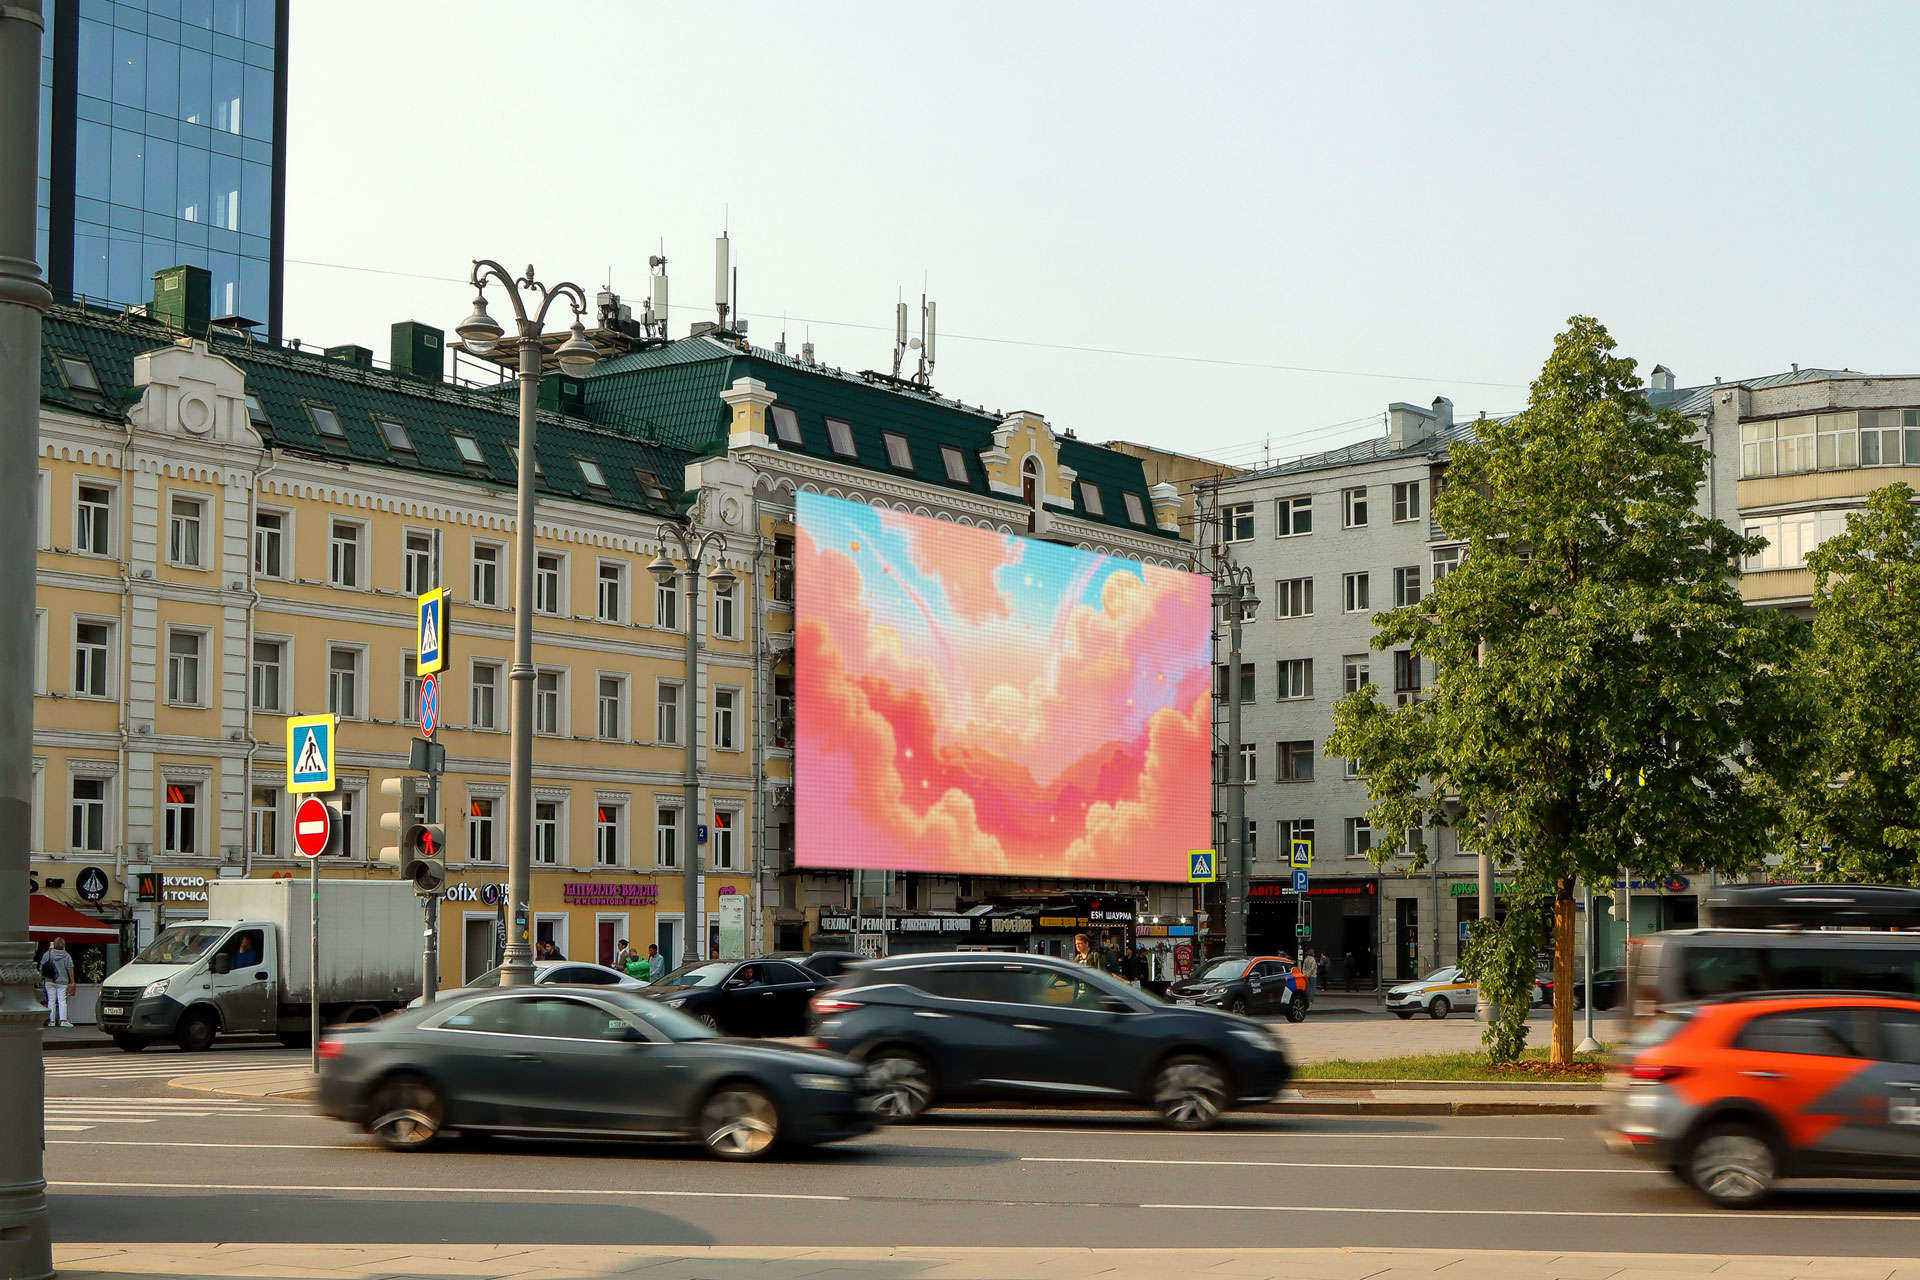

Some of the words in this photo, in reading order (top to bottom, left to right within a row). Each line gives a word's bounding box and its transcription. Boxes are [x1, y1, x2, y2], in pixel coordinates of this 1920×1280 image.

[171, 891, 208, 901] ТОЧКА
[1090, 911, 1103, 920] ESH
[1105, 911, 1132, 921] ШАУРМА
